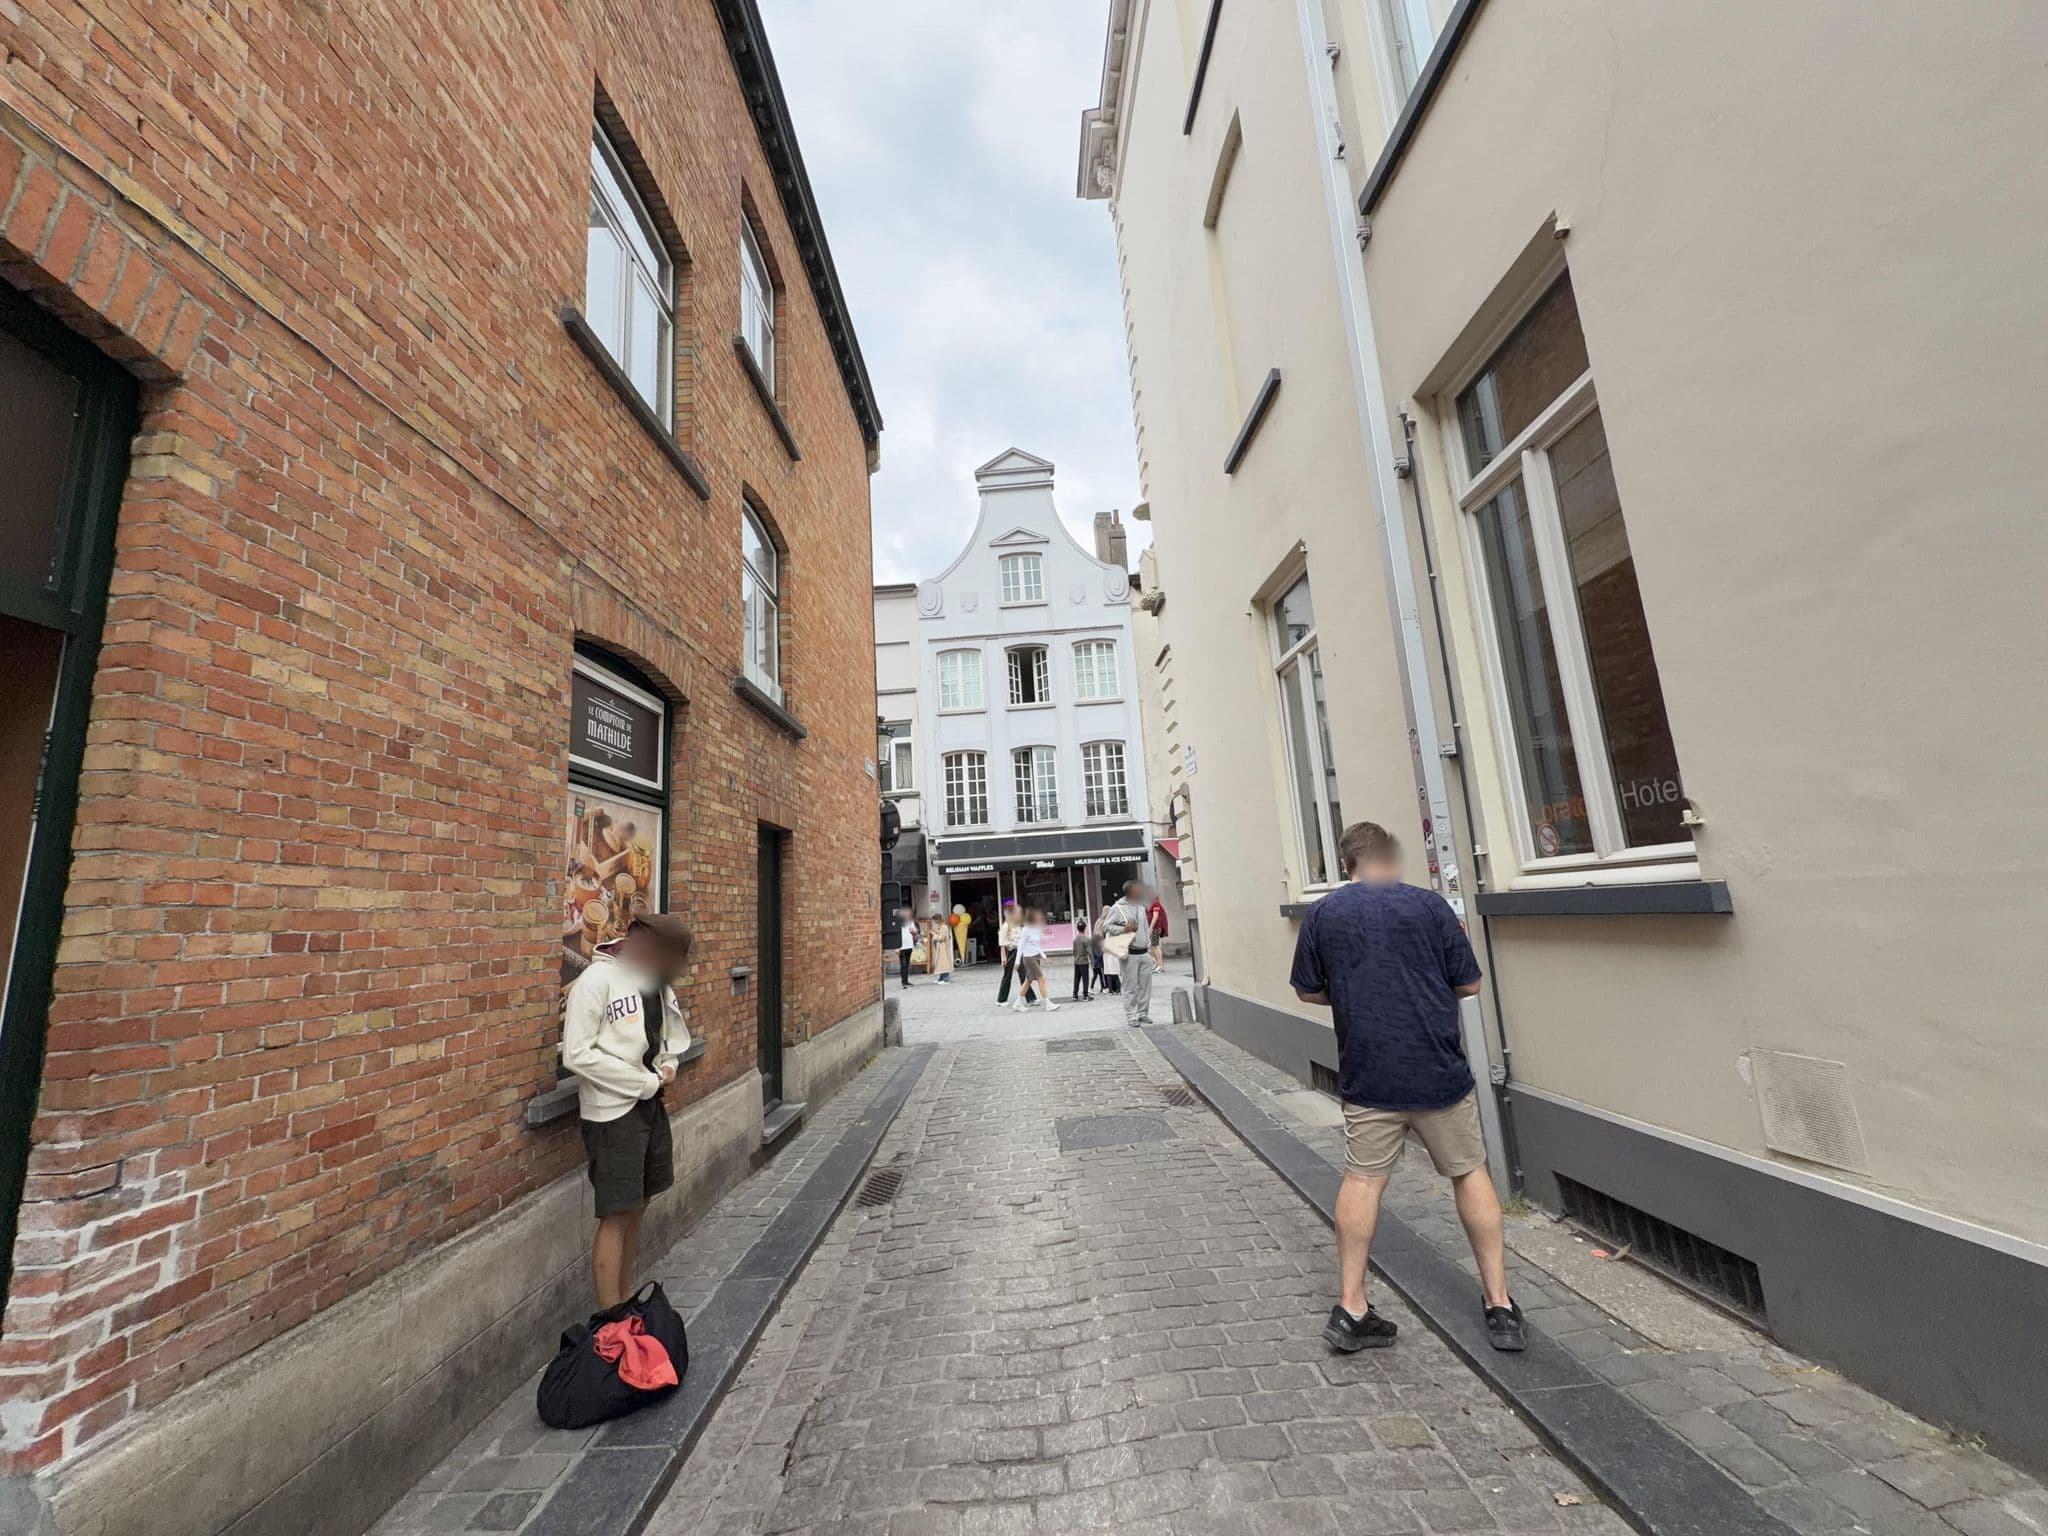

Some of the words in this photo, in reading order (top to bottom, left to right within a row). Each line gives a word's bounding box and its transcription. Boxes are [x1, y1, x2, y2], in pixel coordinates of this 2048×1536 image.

[588, 705, 594, 715] LE
[595, 707, 626, 731] COMPTOIR
[587, 719, 632, 752] MATHILDE
[1074, 857, 1105, 865] MILKSHAKE
